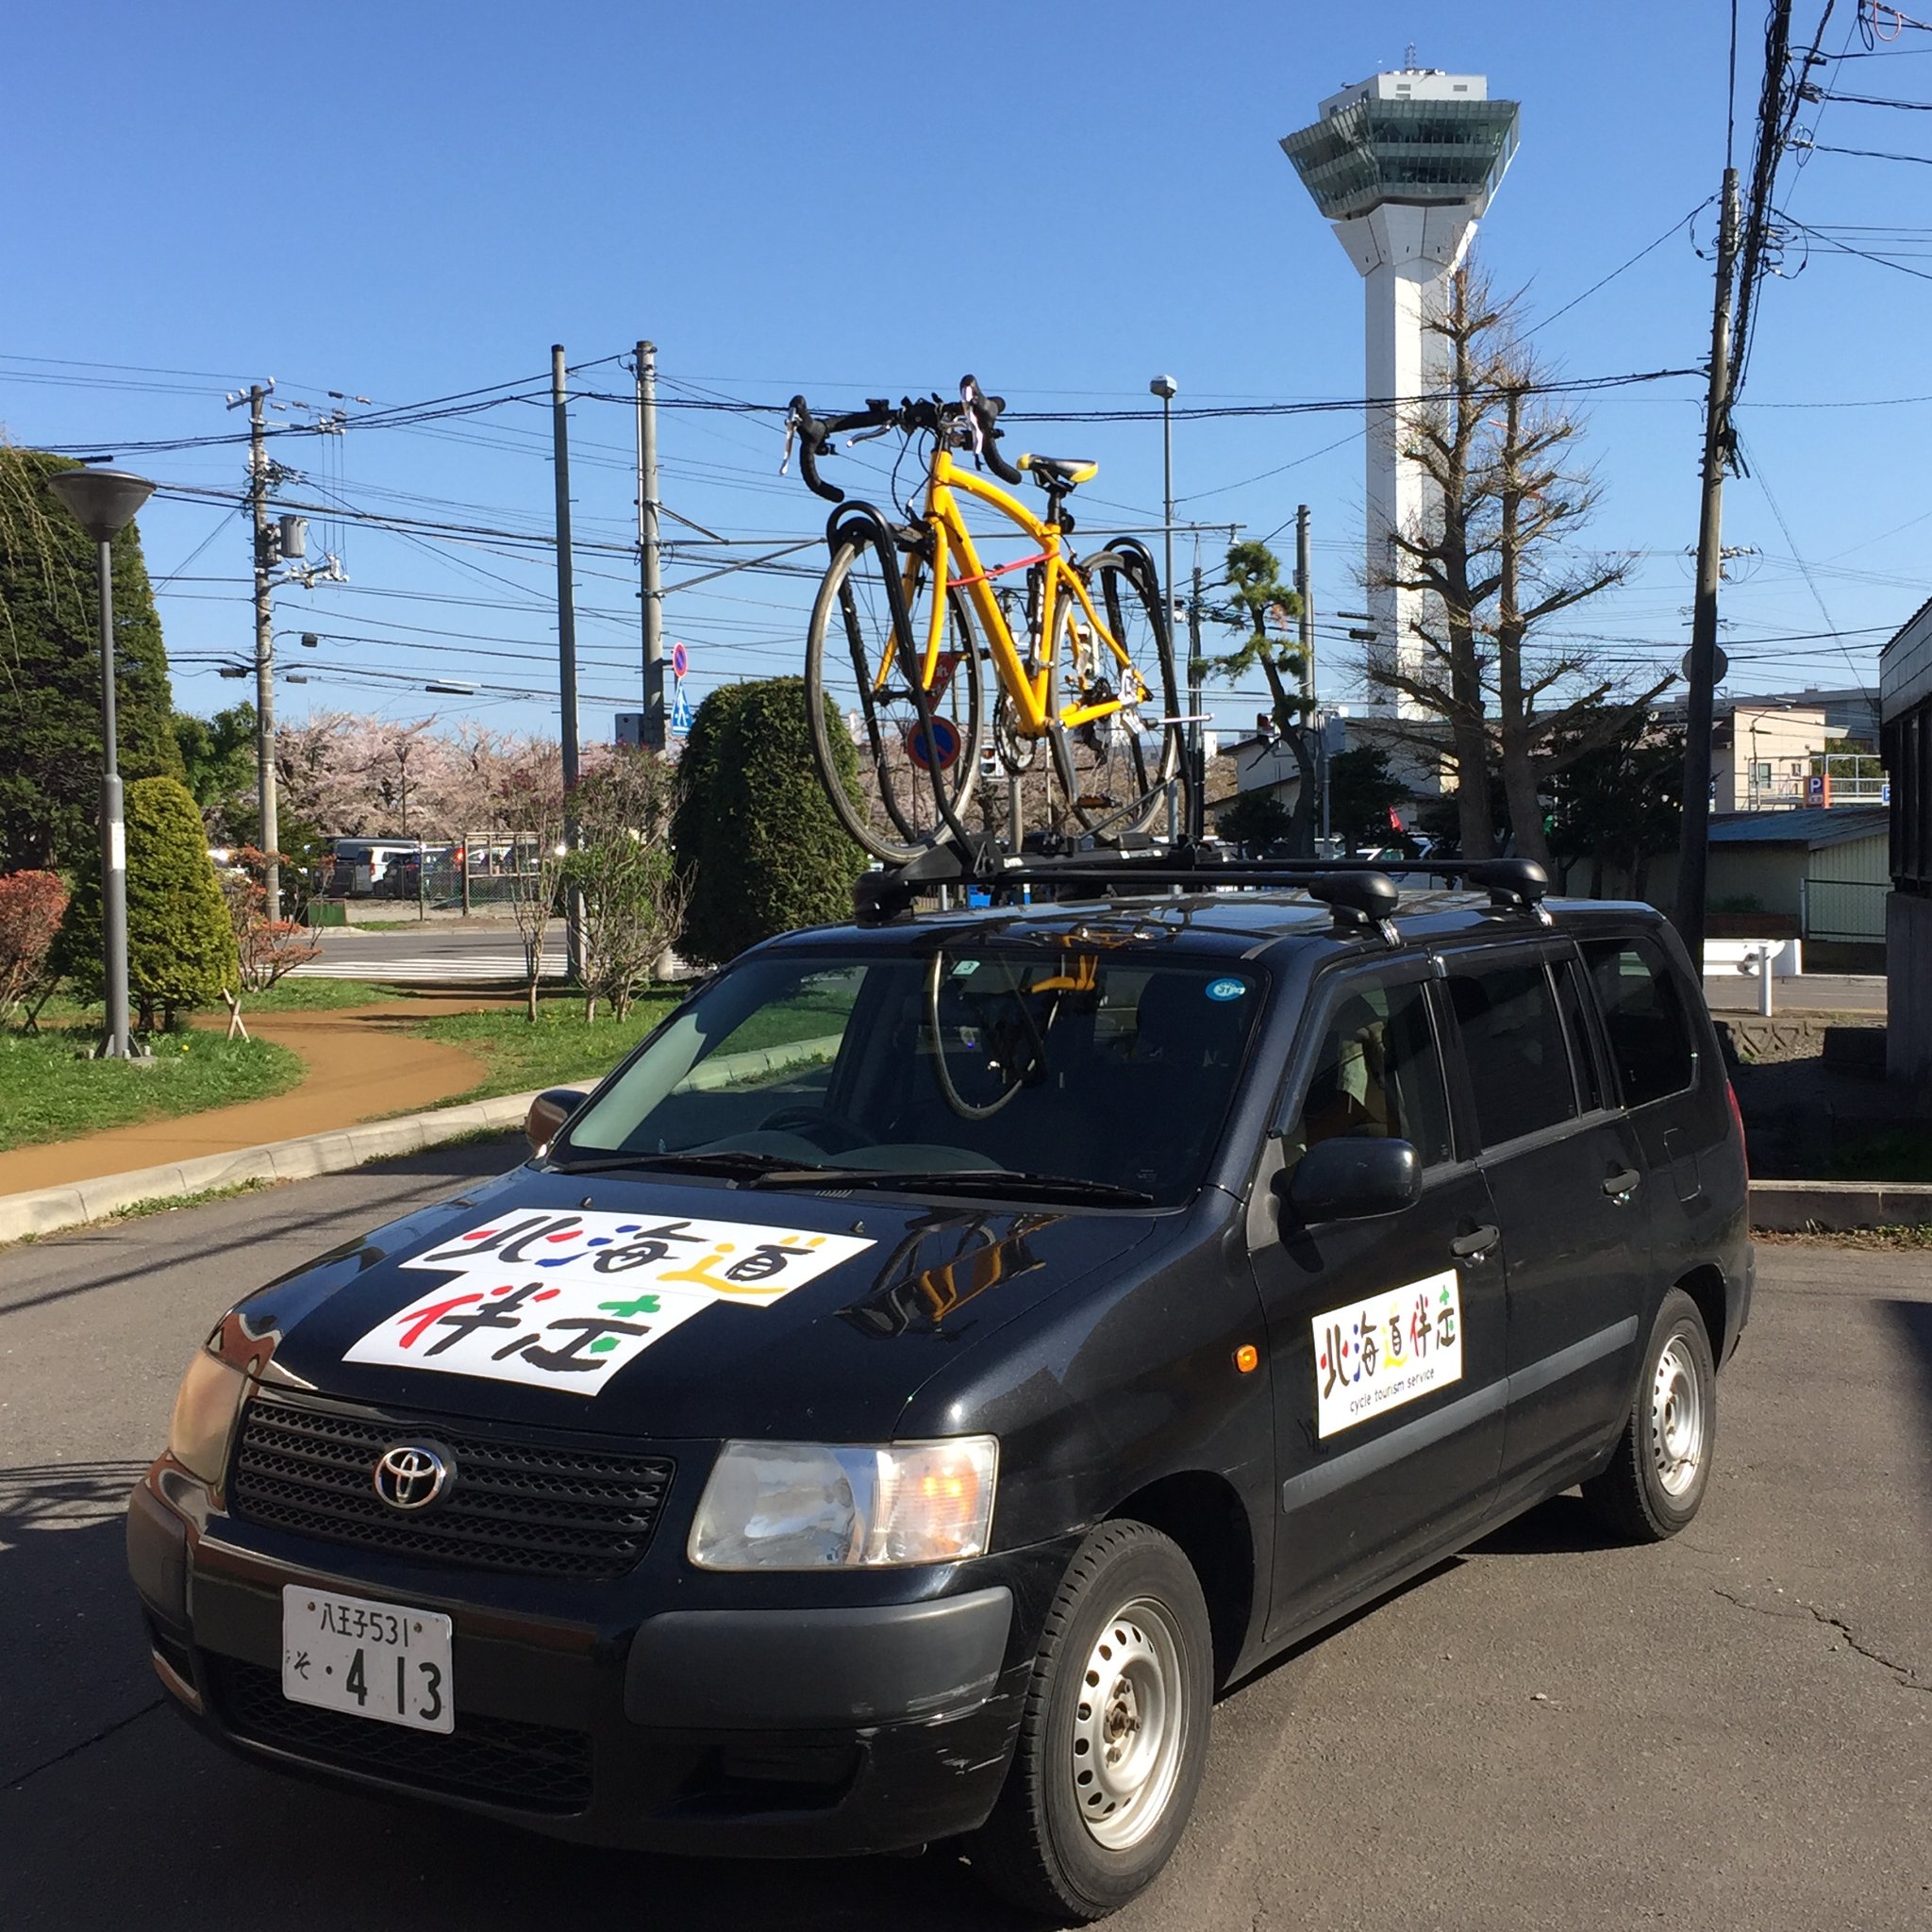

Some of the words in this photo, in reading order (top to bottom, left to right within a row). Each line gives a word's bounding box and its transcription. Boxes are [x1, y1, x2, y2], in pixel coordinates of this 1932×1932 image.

[1810, 777, 1822, 793] P
[424, 1214, 826, 1295] 北海道
[1350, 1393, 1372, 1415] cycle
[1374, 1381, 1405, 1402] tourism
[1407, 1368, 1434, 1389] service
[320, 1603, 408, 1648] 八王子531
[293, 1650, 311, 1680] そ
